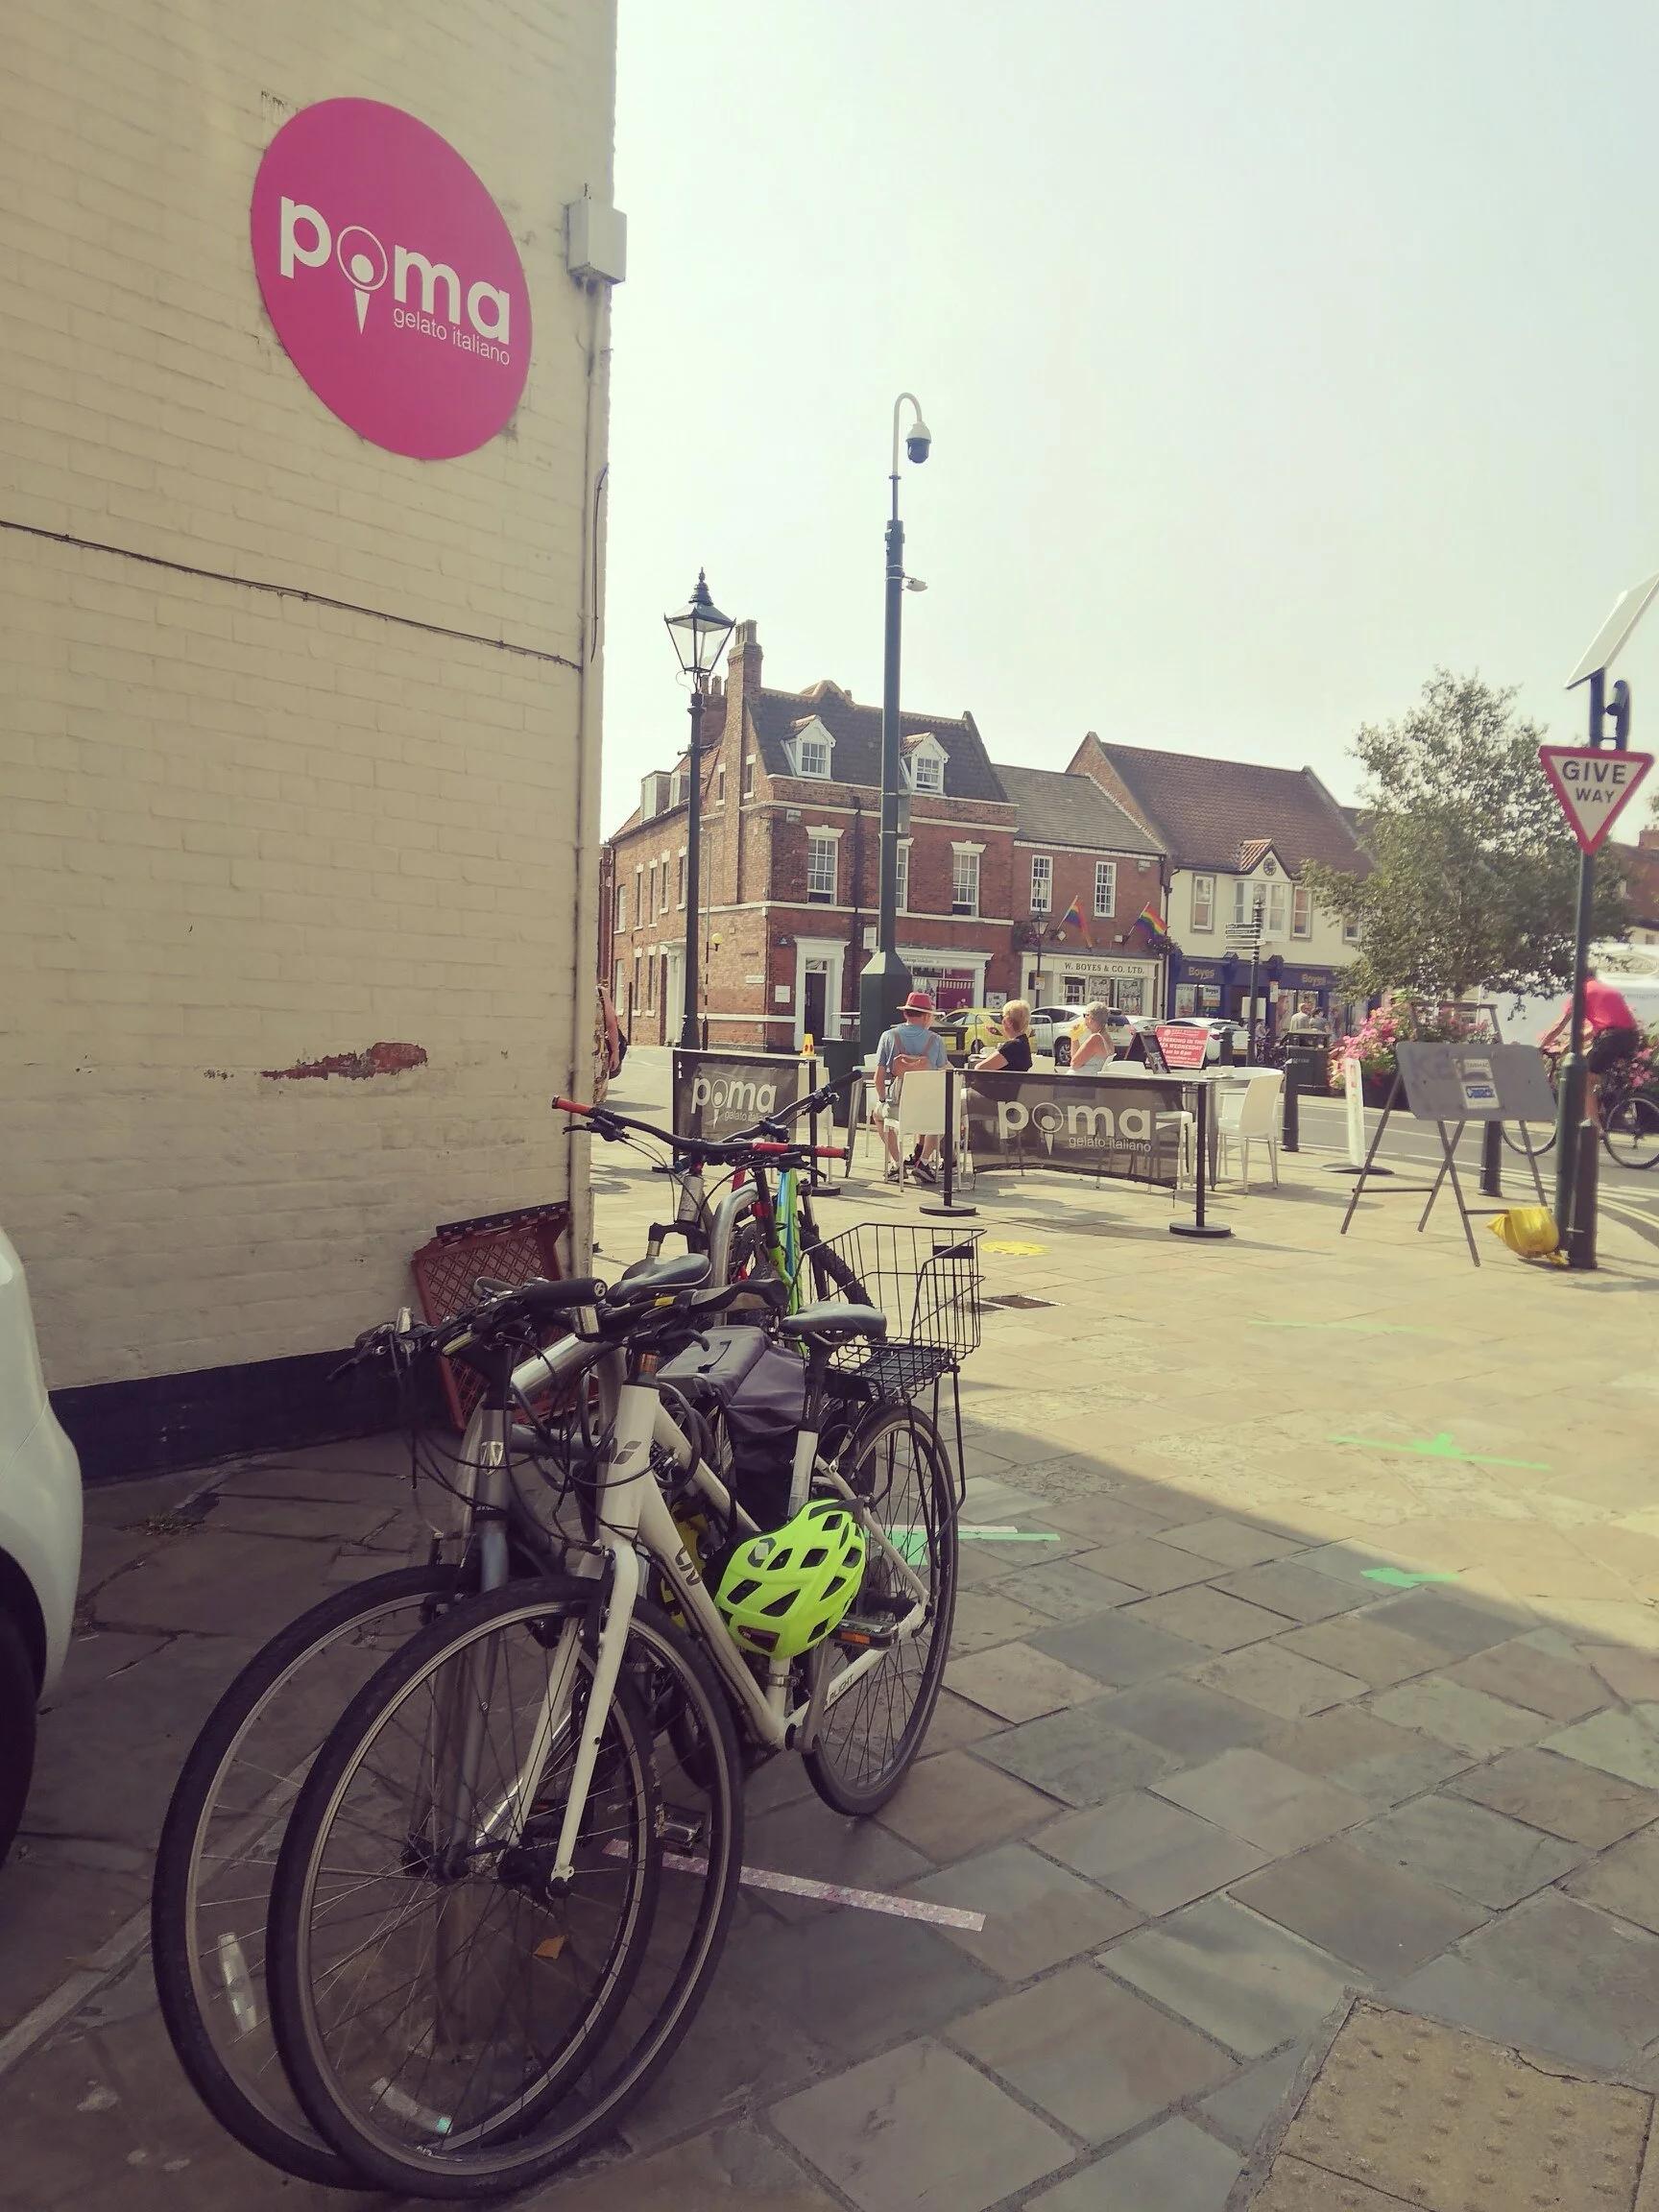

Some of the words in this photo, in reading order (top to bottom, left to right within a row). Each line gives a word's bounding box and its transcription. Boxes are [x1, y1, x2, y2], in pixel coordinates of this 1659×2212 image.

[279, 195, 511, 346] poma
[393, 307, 447, 341] gelato
[452, 325, 511, 366] italiano
[1562, 760, 1627, 784] GIVE
[1575, 787, 1615, 803] WAY
[1075, 963, 1101, 972] BOYES
[1188, 966, 1214, 979] Boyes
[690, 1077, 778, 1115] poma
[997, 1100, 1151, 1141] poma
[1068, 1135, 1105, 1148] gelato
[1109, 1137, 1151, 1152] italiano
